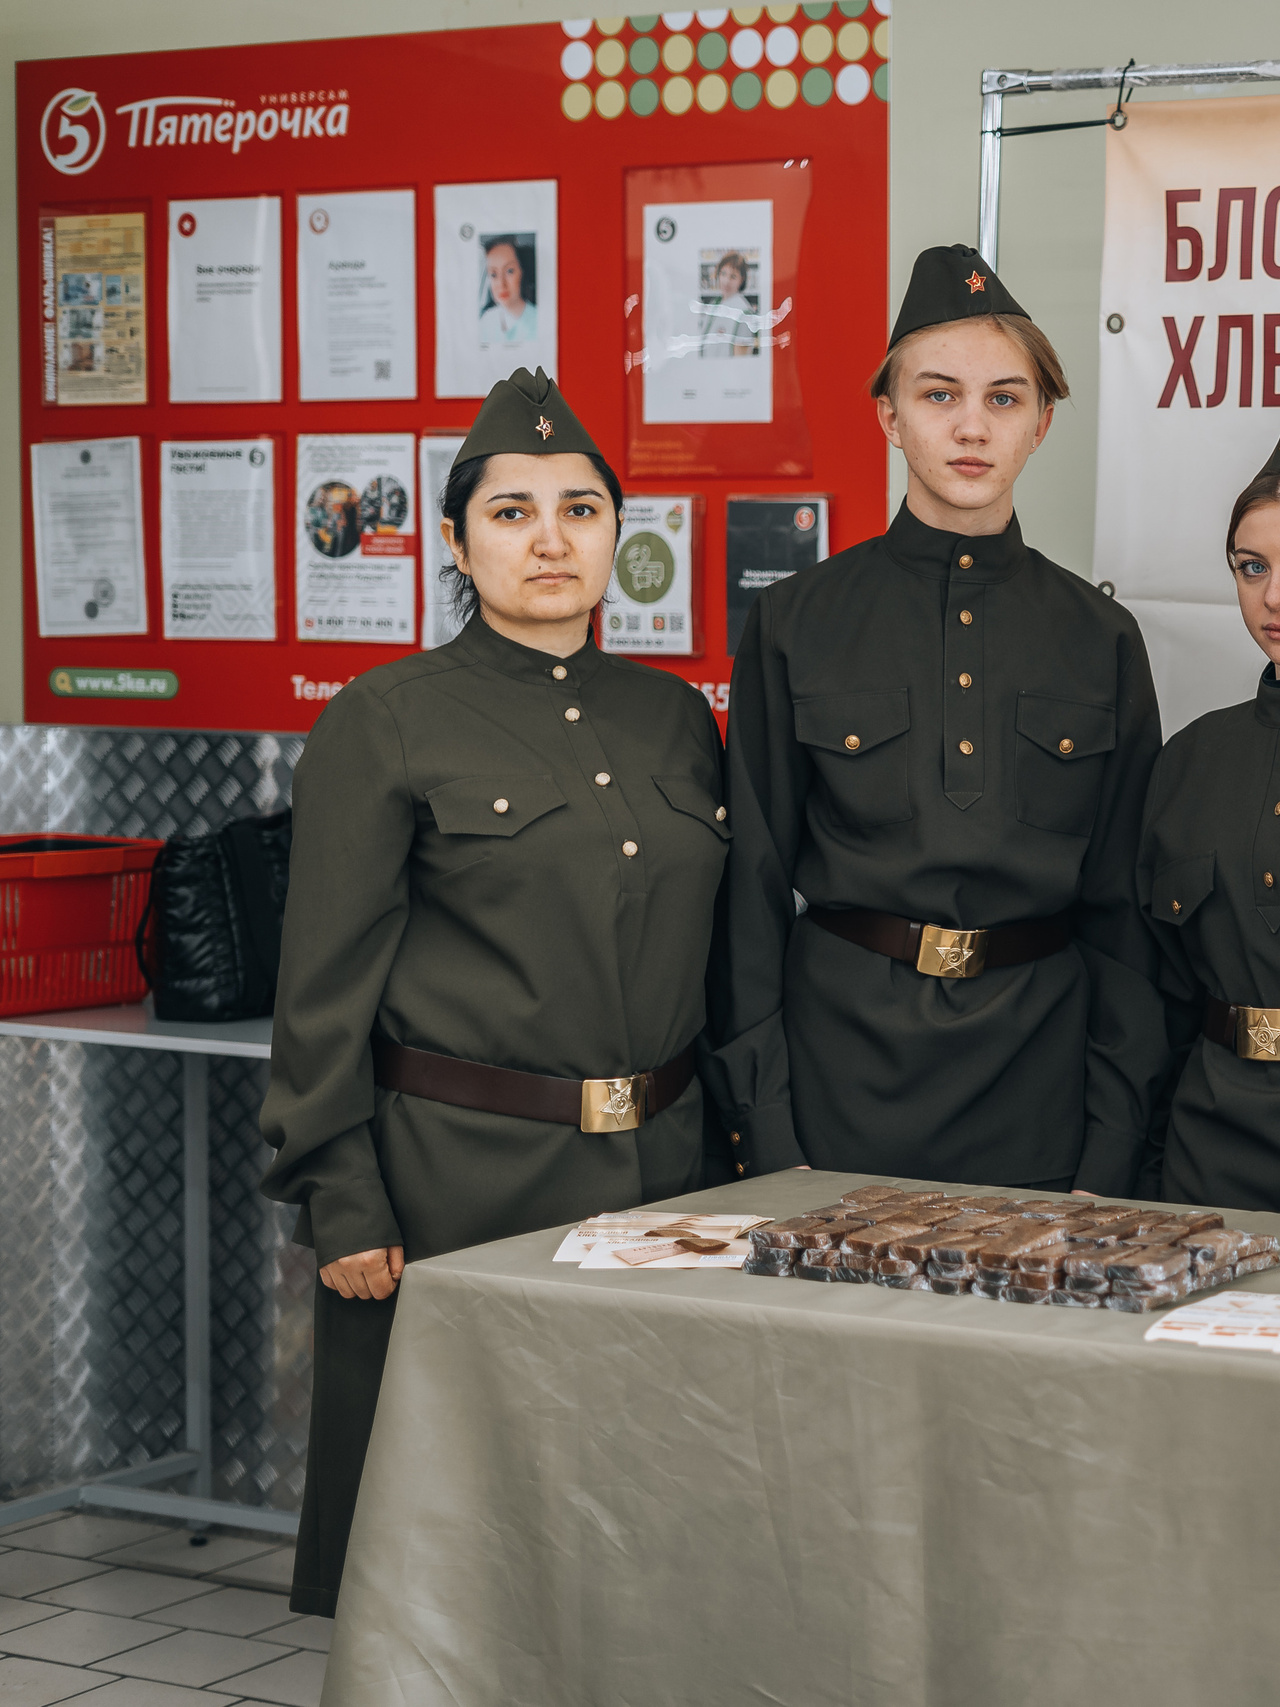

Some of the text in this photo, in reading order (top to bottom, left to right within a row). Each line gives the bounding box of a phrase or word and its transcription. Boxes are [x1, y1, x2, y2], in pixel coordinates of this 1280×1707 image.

[259, 88, 349, 105] УНИВЕРСАМ
[75, 673, 167, 694] www.5ka.ru
[290, 674, 355, 700] Теле
